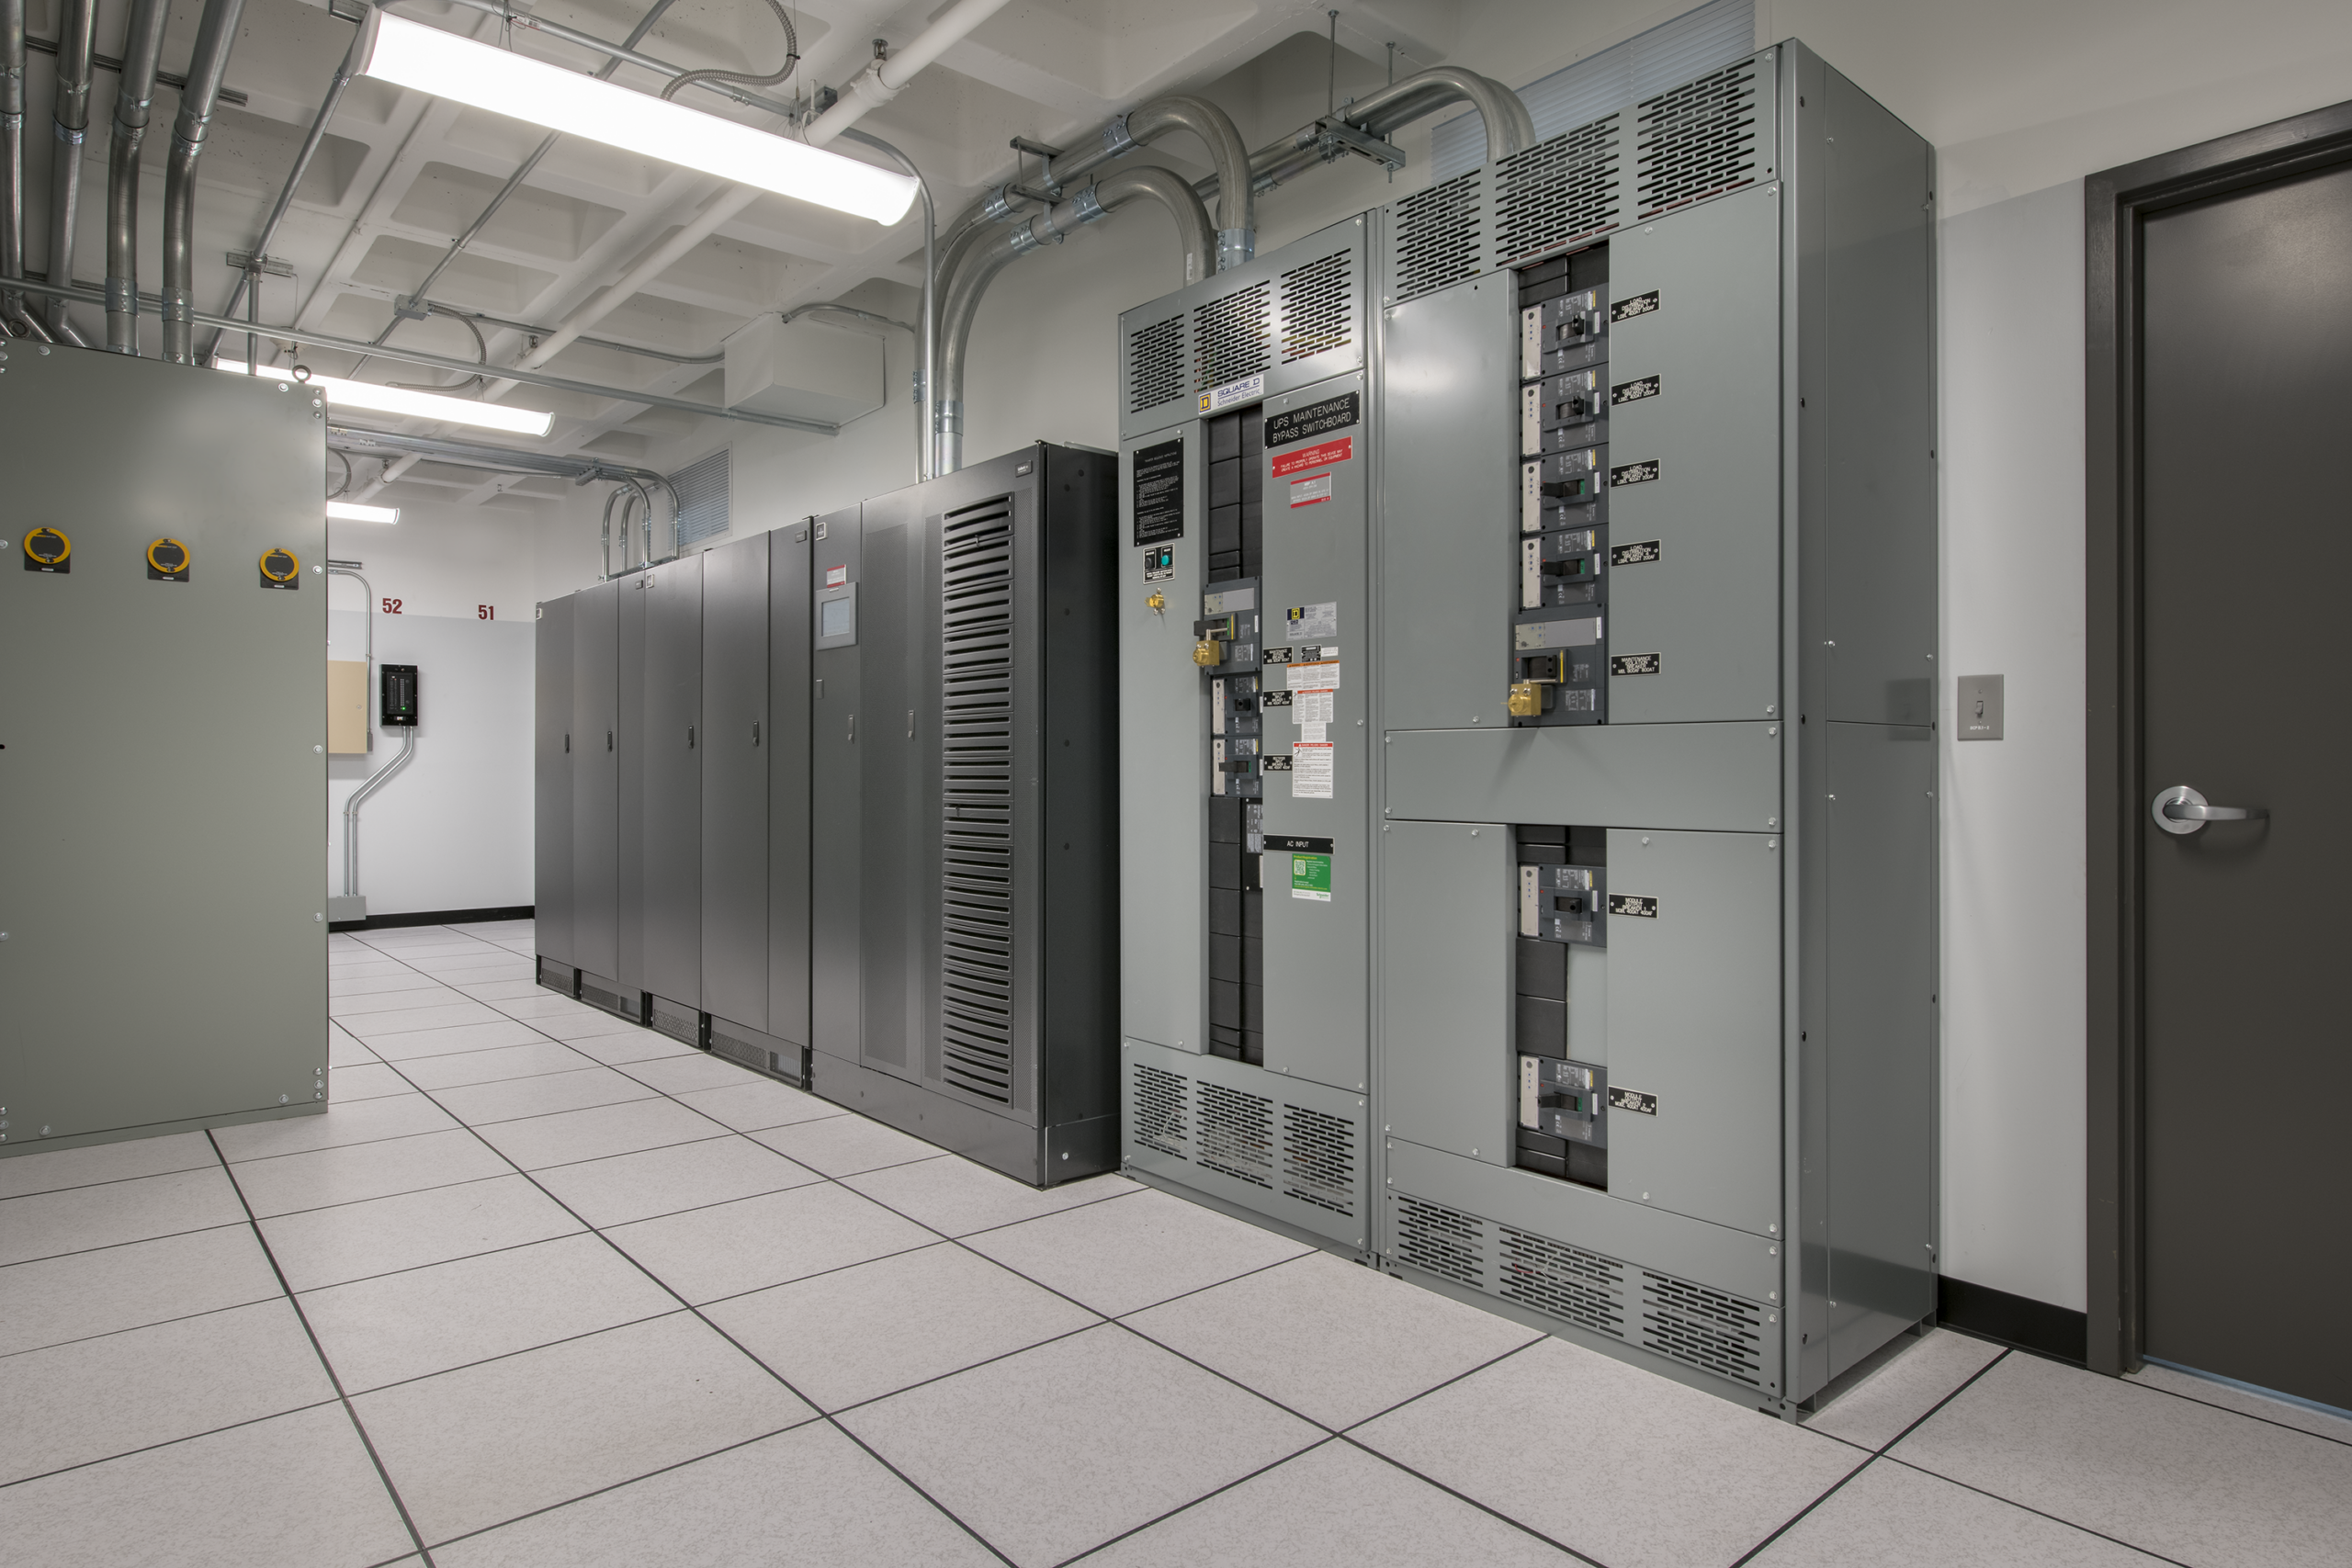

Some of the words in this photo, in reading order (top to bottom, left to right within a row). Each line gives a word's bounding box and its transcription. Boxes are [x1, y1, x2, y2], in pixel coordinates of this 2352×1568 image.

[1218, 381, 1250, 397] SQUARE
[1218, 395, 1240, 406] Schneider
[1242, 389, 1260, 398] Electric
[1273, 417, 1289, 429] UPS
[1293, 398, 1350, 423] MAINTENANCE
[1273, 427, 1299, 443] BYPASS
[1302, 412, 1351, 434] SWITCHBOARD
[1302, 449, 1319, 458] WARNING
[382, 598, 402, 614] 52
[478, 604, 494, 620] 51
